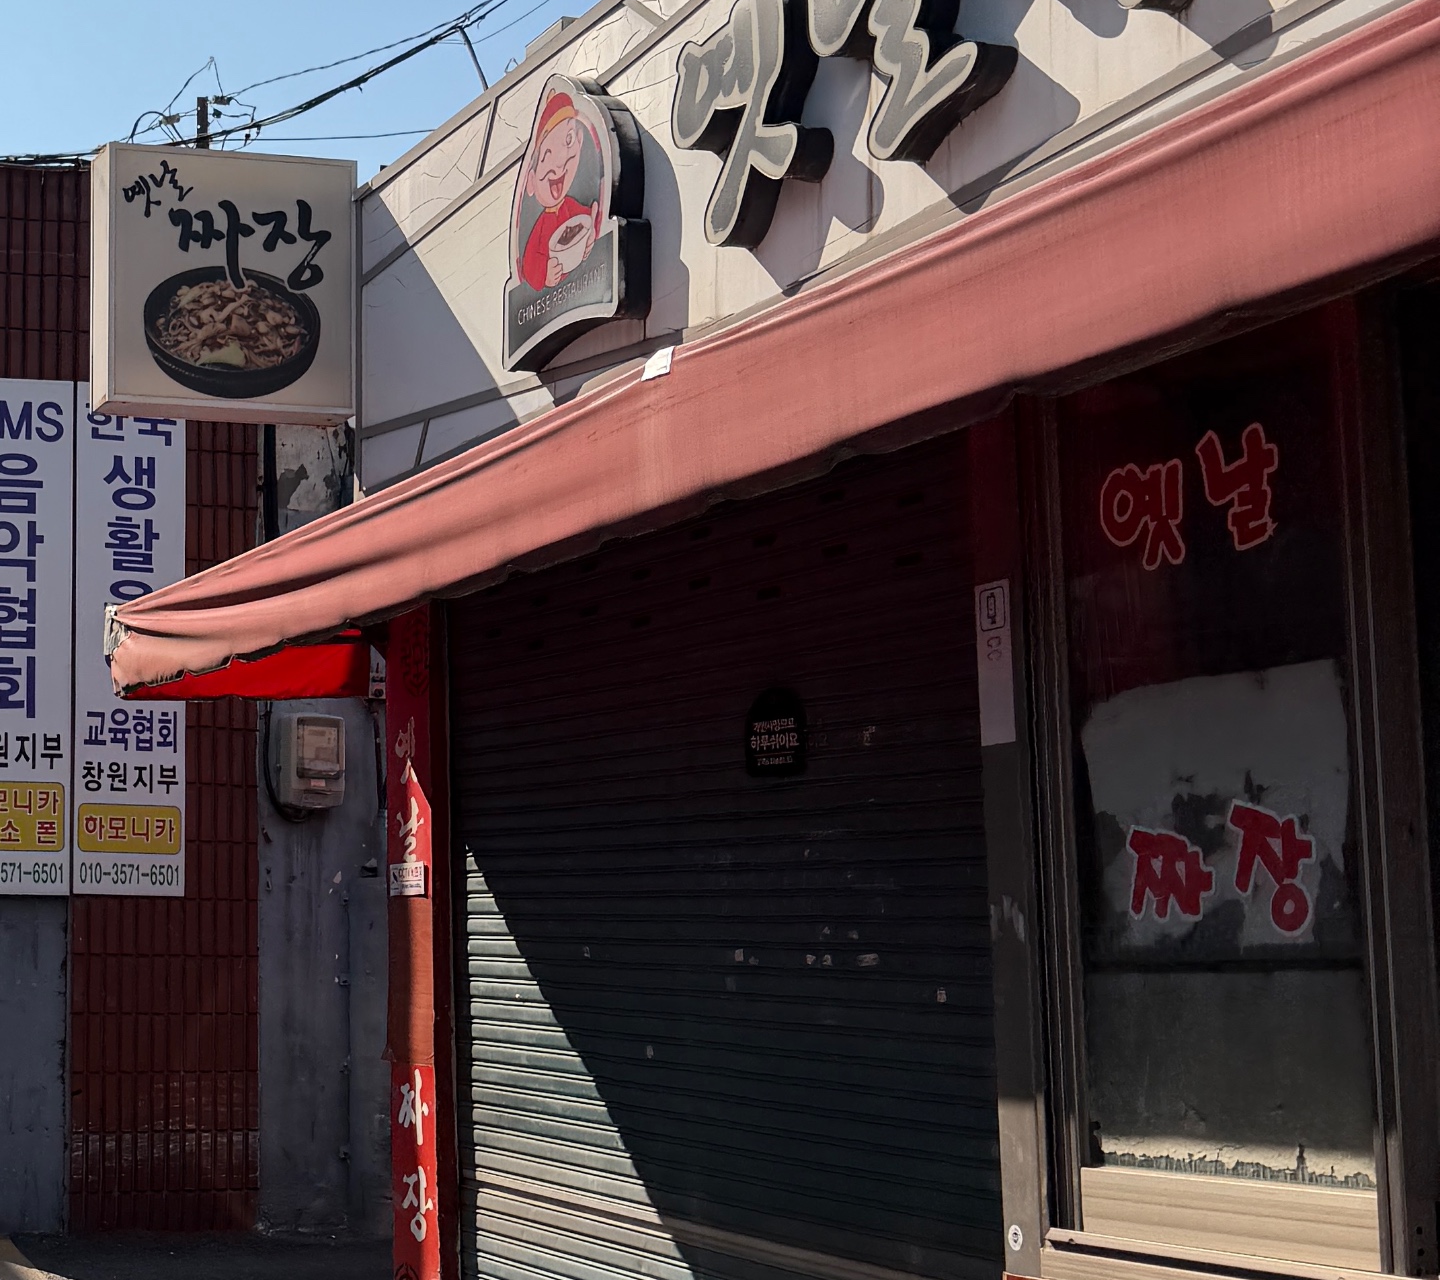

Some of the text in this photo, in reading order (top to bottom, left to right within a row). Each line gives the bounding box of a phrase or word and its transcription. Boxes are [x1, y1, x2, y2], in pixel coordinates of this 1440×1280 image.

[122, 160, 332, 291] 옛날 짜장
[517, 263, 606, 326] CHINESE RESTAURANT
[1099, 421, 1279, 571] 옛날
[83, 708, 178, 754] 교육협회
[81, 761, 179, 795] 창원지부
[83, 813, 176, 845] 하모니카
[79, 861, 181, 887] 010-3571-6501
[1126, 799, 1317, 940] 짜장
[397, 1067, 434, 1243] 짜장
